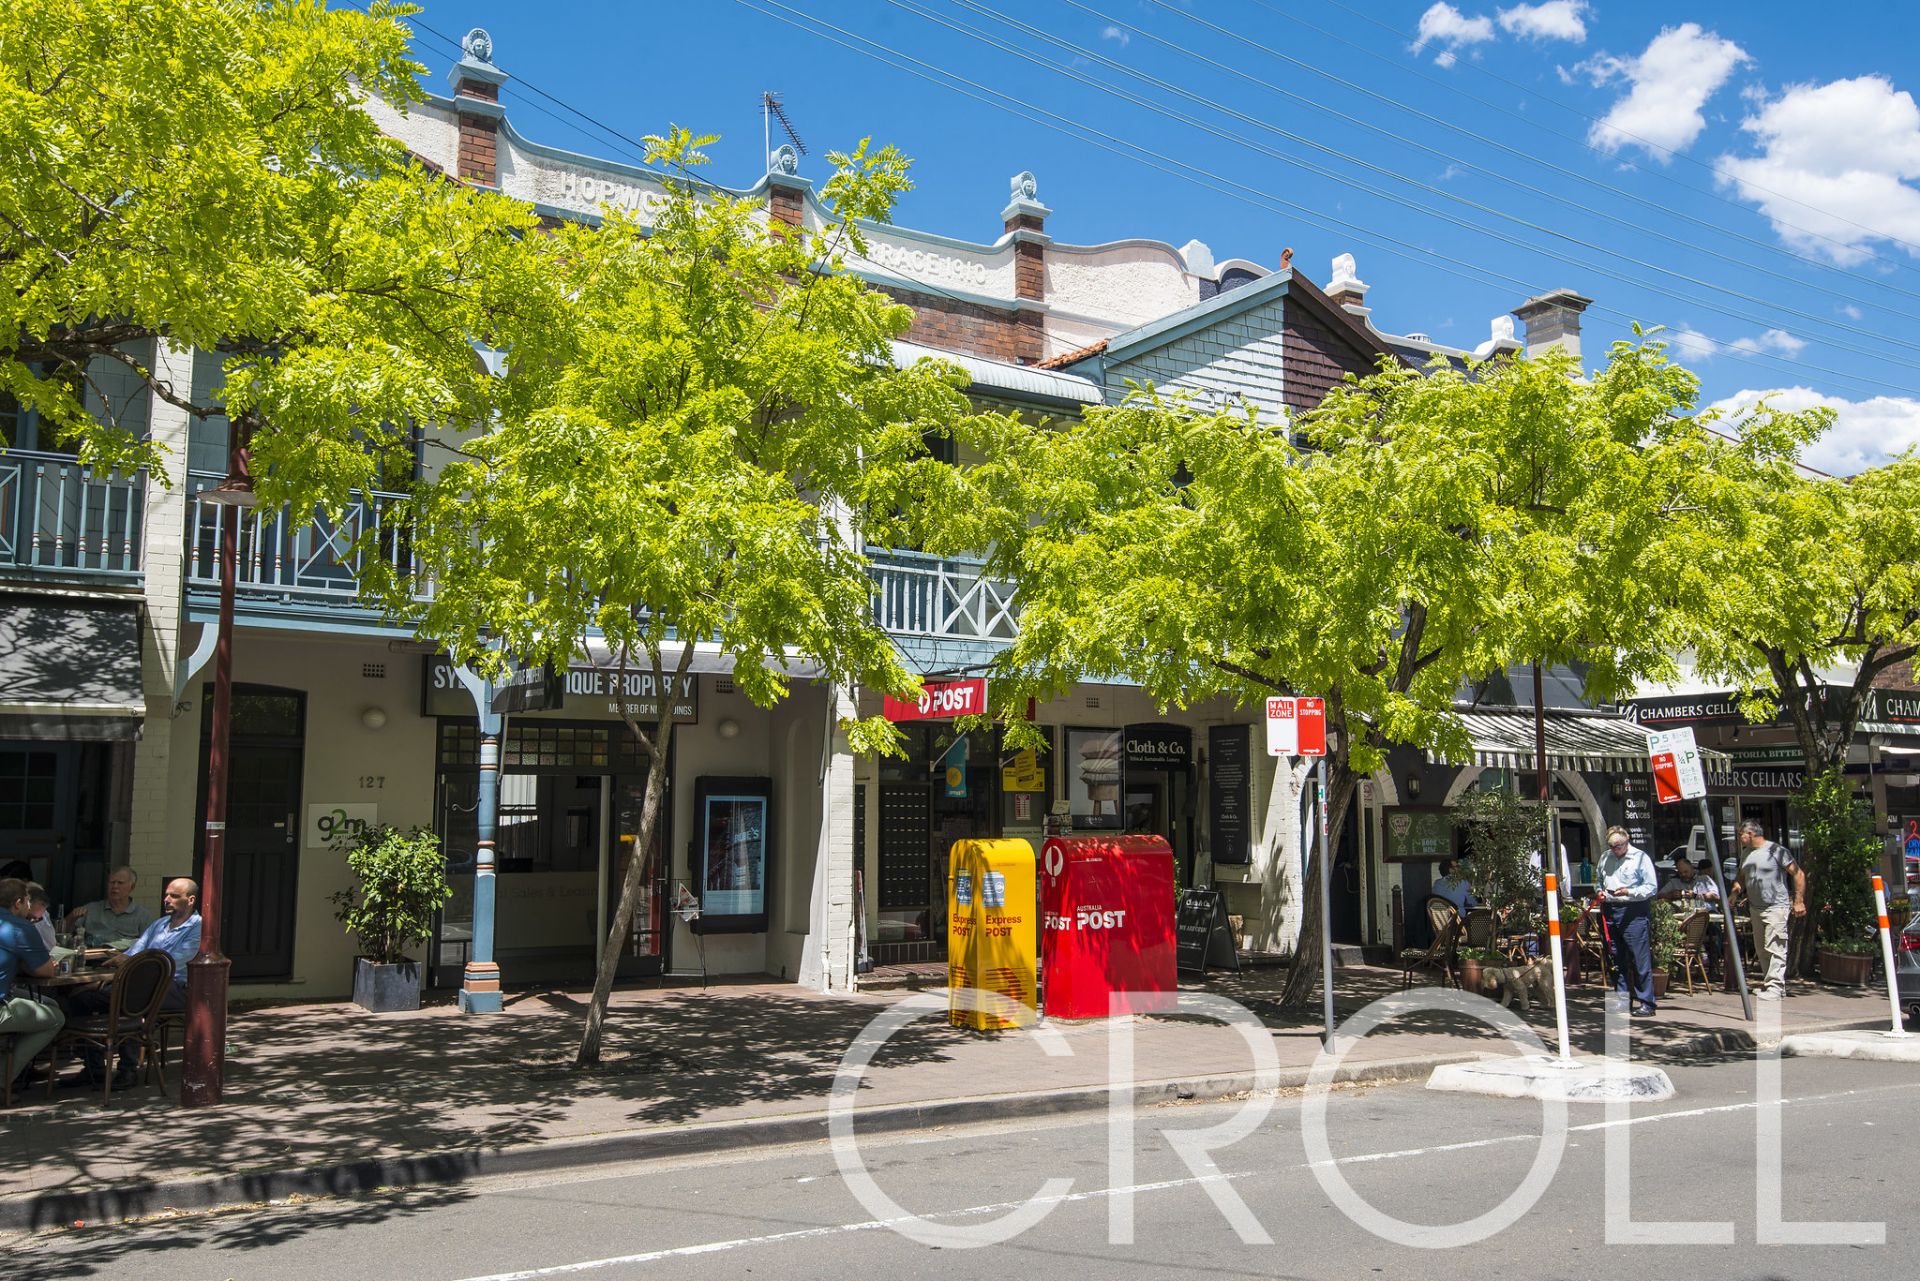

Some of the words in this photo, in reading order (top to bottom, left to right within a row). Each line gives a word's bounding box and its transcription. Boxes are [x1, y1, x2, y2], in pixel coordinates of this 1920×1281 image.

[560, 171, 673, 215] HOPWO
[609, 673, 692, 698] PROPERY
[933, 687, 974, 711] POST
[1269, 701, 1293, 710] MAIL
[1270, 709, 1293, 718] ZONE
[1640, 704, 1703, 719] CHAMBERS
[1706, 702, 1741, 715] CELLA
[1126, 739, 1155, 754] Cloth
[1158, 741, 1168, 754] &
[359, 776, 385, 789] 127
[1707, 771, 1748, 788] MBERS
[1751, 772, 1802, 789] CELLARS
[317, 808, 366, 842] g2m
[952, 913, 977, 925] Express
[985, 914, 1022, 926] Express
[1044, 916, 1072, 931] POST
[1077, 910, 1126, 930] POST
[952, 925, 971, 937] POST
[985, 926, 1013, 937] POST
